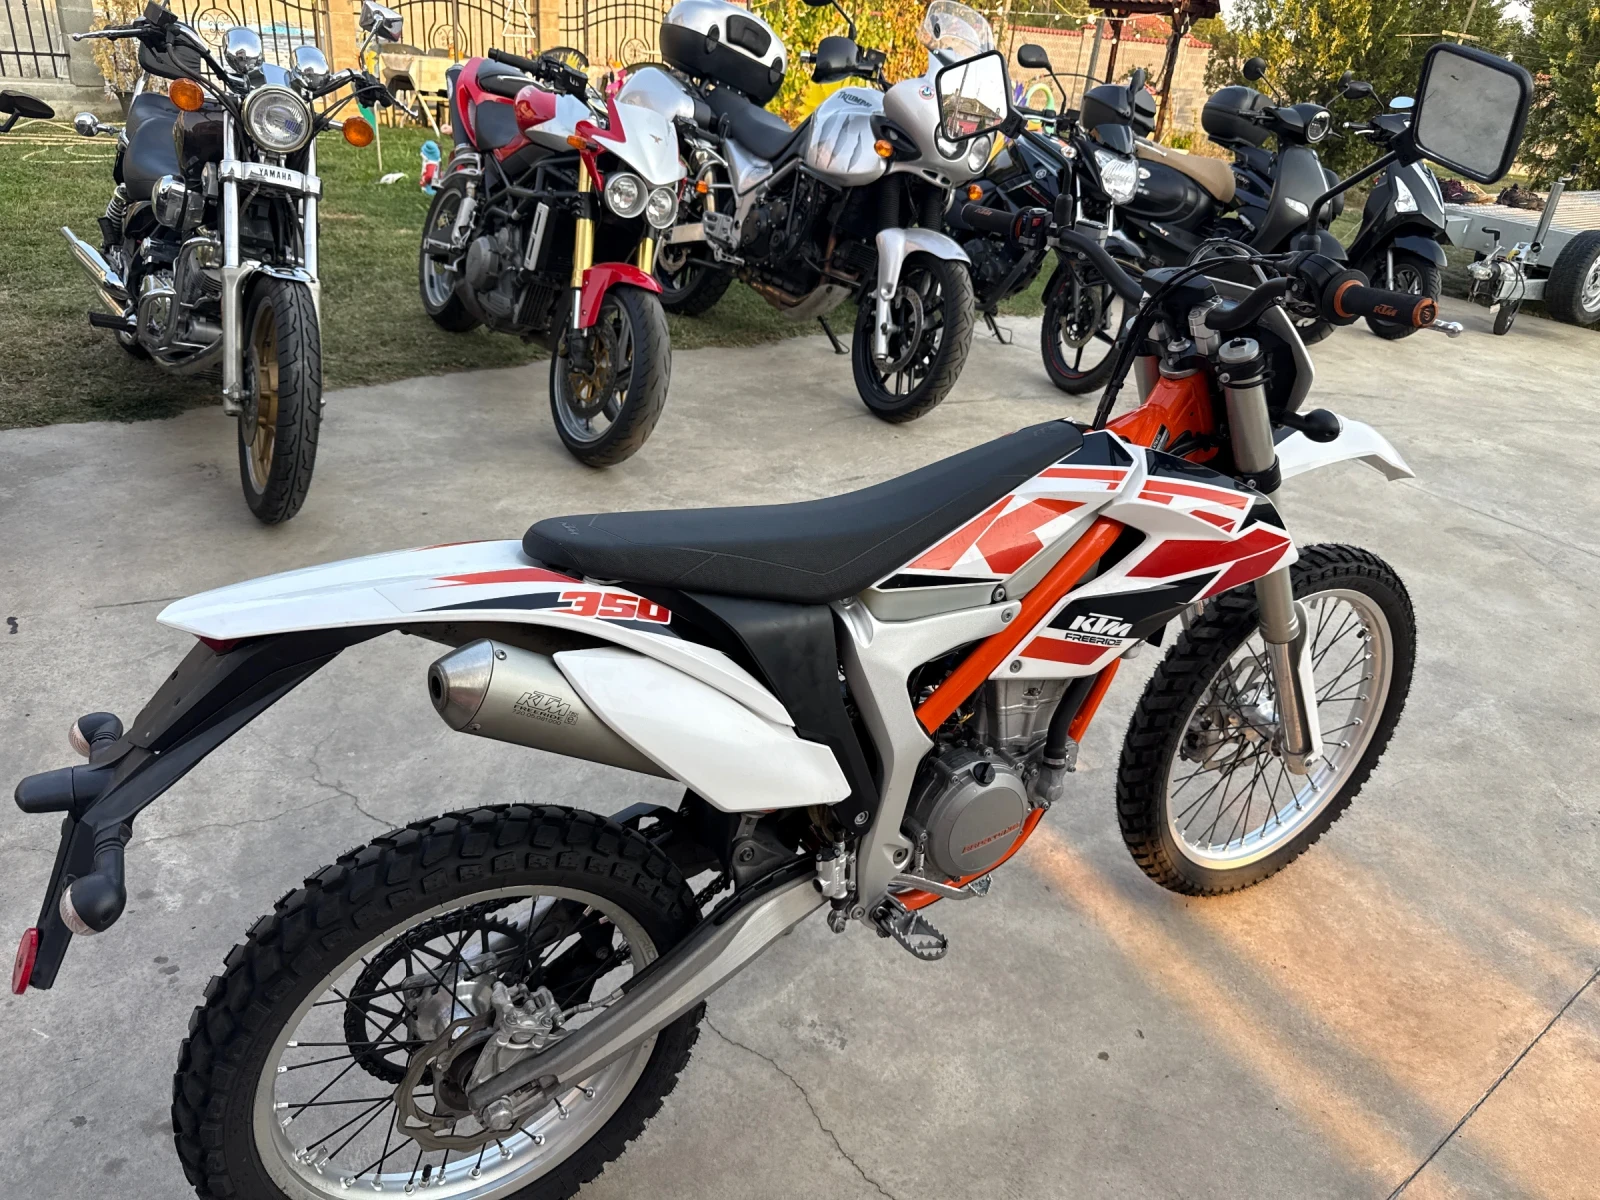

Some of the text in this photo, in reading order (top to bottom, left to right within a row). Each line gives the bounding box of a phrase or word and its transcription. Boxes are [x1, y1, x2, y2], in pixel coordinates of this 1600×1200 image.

[259, 168, 292, 181] YAMAHA
[1373, 303, 1399, 317] KTM
[555, 591, 671, 624] 350
[1068, 612, 1133, 637] KTM
[1065, 632, 1123, 646] FREERIDE
[516, 691, 571, 716] KTM
[513, 704, 563, 721] FREERIDE
